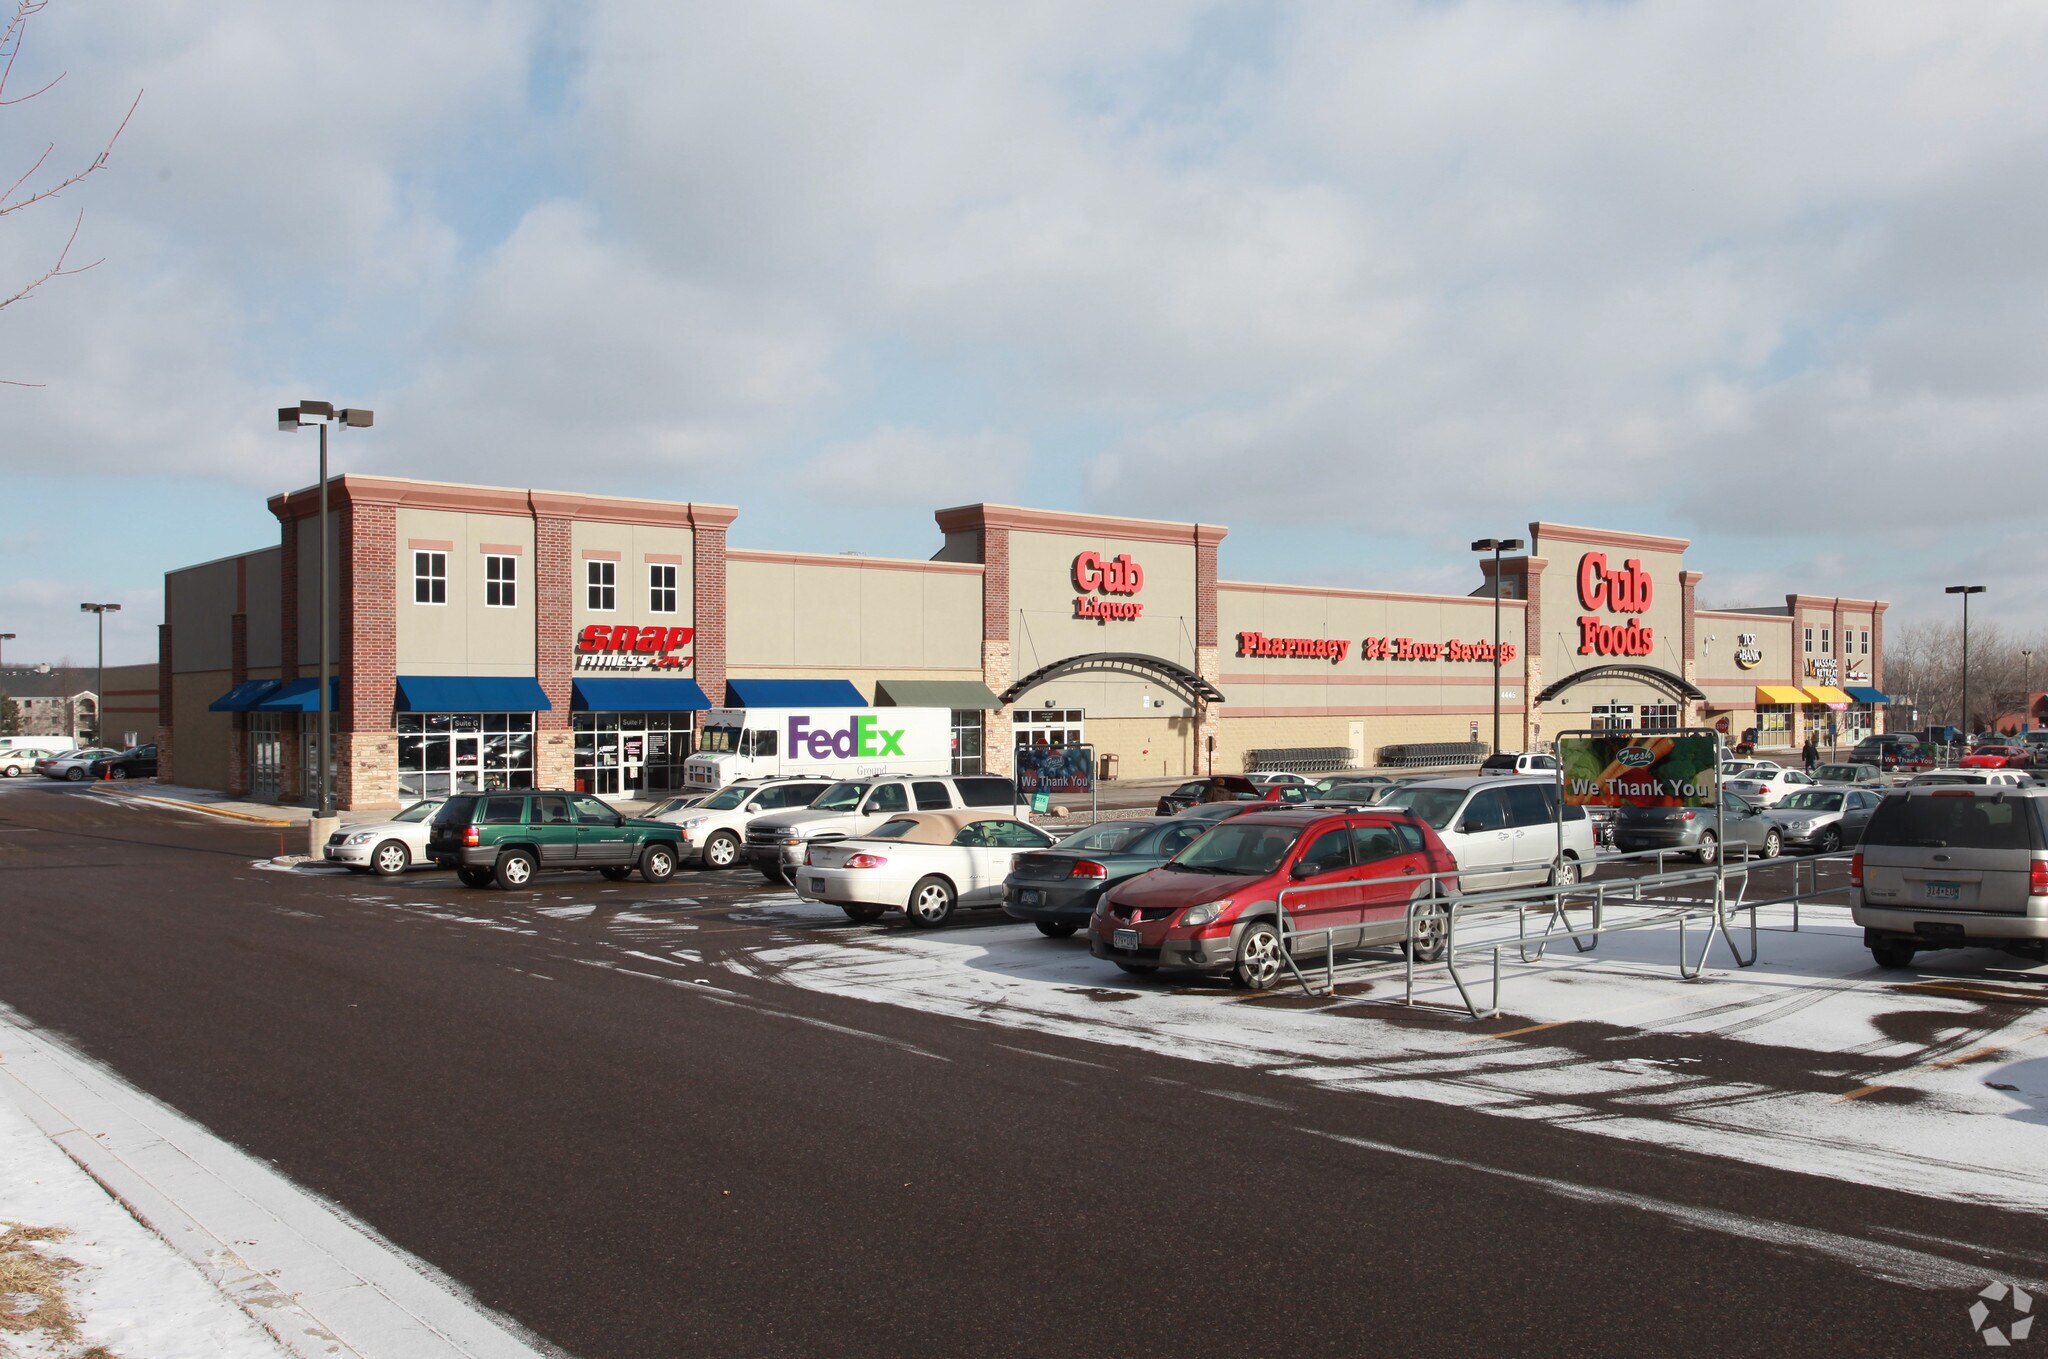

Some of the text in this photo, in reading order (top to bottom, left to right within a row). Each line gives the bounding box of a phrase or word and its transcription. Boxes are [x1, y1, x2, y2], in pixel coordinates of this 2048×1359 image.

[1076, 551, 1144, 594] Cub
[1580, 551, 1653, 613] Cub
[1078, 596, 1144, 622] Liquor
[1581, 616, 1654, 656] Foods
[1743, 633, 1756, 645] TCF
[1240, 631, 1351, 661] Pharmacy
[1366, 637, 1391, 658] 24
[1396, 637, 1445, 660] Hour
[1742, 649, 1761, 661] BANK
[580, 654, 648, 668] FITNESS
[1814, 659, 1838, 668] MASSAGE
[1816, 668, 1838, 678] RETREAT
[1501, 691, 1516, 699] 4445
[788, 715, 905, 760] FedEx
[1619, 747, 1653, 765] Fresh
[856, 764, 887, 776] Ground
[1021, 776, 1088, 787] We Thank You
[1571, 778, 1709, 798] We Thank You
